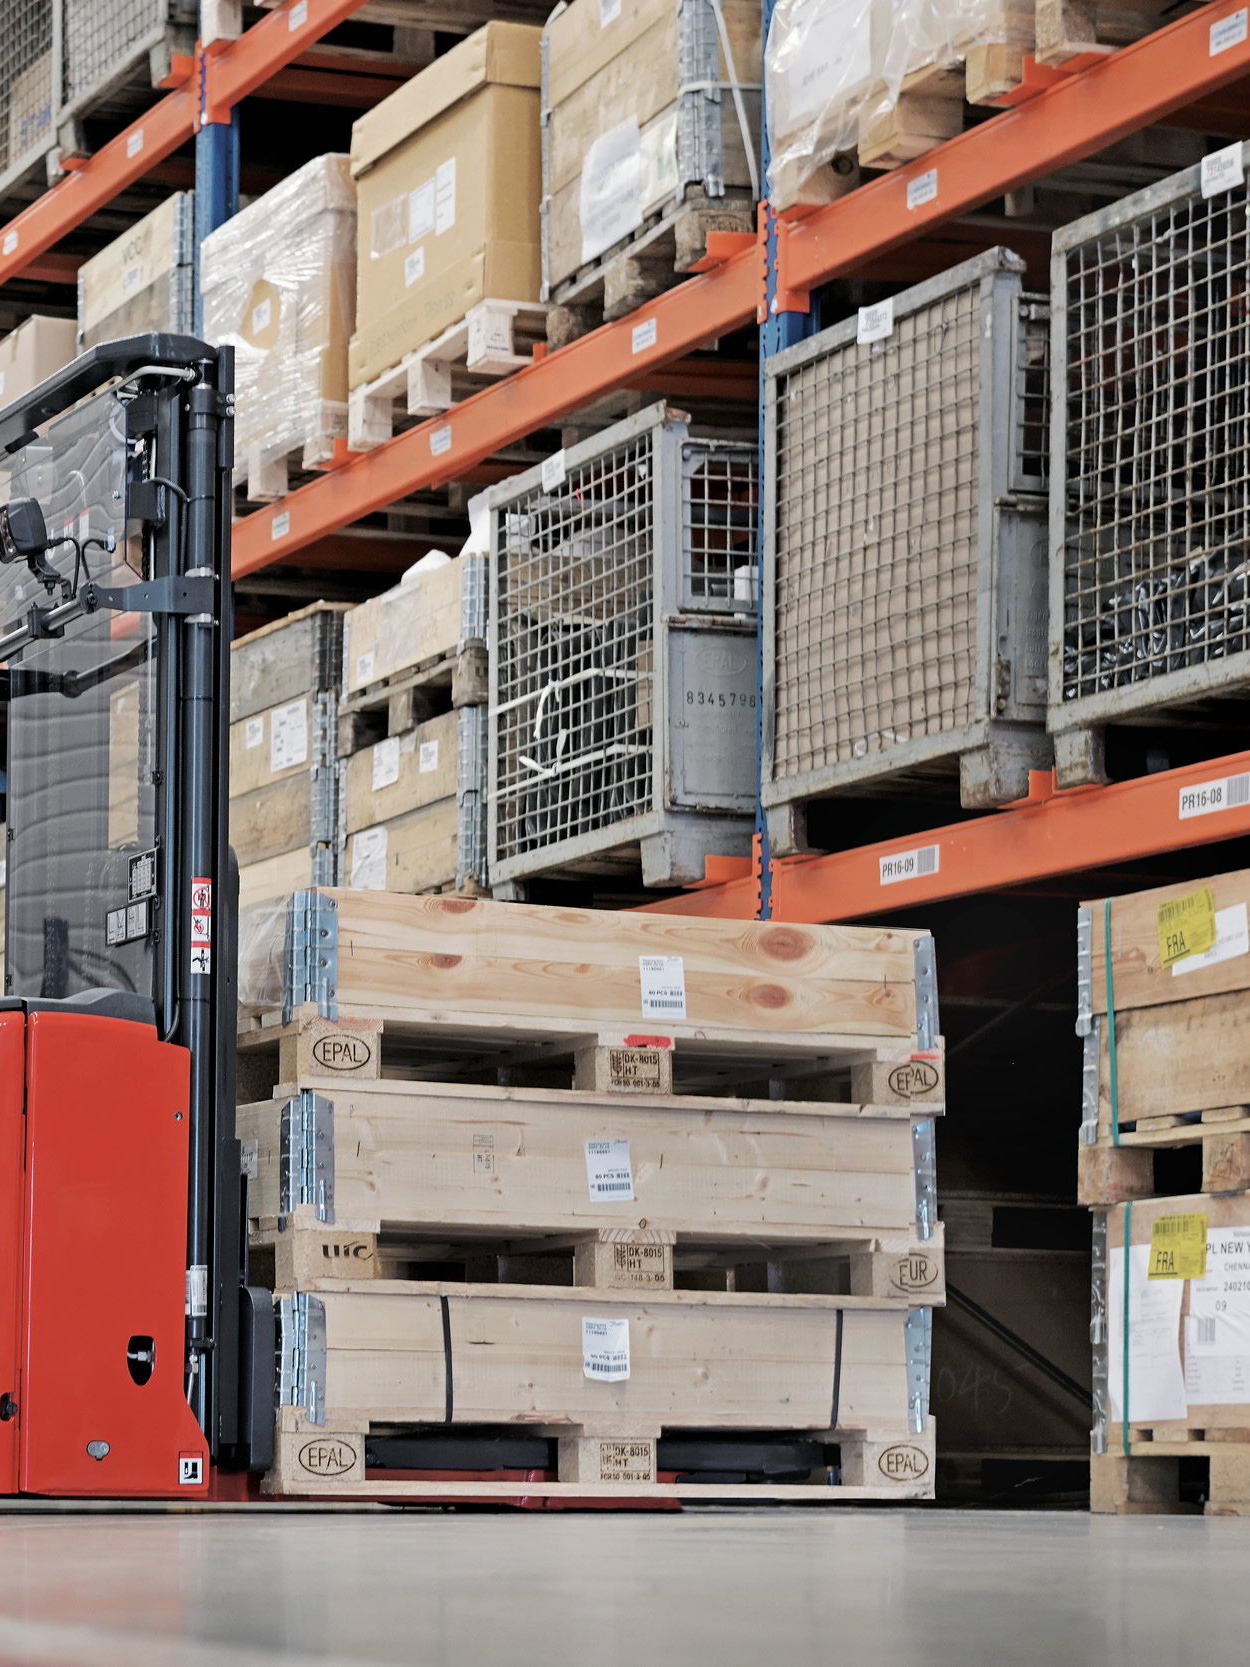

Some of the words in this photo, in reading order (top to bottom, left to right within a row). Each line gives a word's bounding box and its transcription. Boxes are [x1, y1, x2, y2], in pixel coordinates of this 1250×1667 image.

[1182, 786, 1222, 811] PR16-08
[882, 857, 914, 878] PR16-09
[1166, 931, 1186, 956] FRA
[322, 1042, 362, 1062] EPAL
[625, 1066, 637, 1075] HT
[897, 1067, 931, 1091] EPAL
[629, 1246, 662, 1258] DK-8015
[1220, 1241, 1244, 1254] NEW
[629, 1258, 641, 1269] HT
[1155, 1250, 1174, 1271] FRA
[899, 1260, 927, 1285] EUR
[1215, 1299, 1227, 1312] 09
[308, 1447, 348, 1469] EPAL
[615, 1446, 649, 1457] DK-8015
[615, 1458, 628, 1468] HT
[886, 1452, 921, 1473] EPAL
